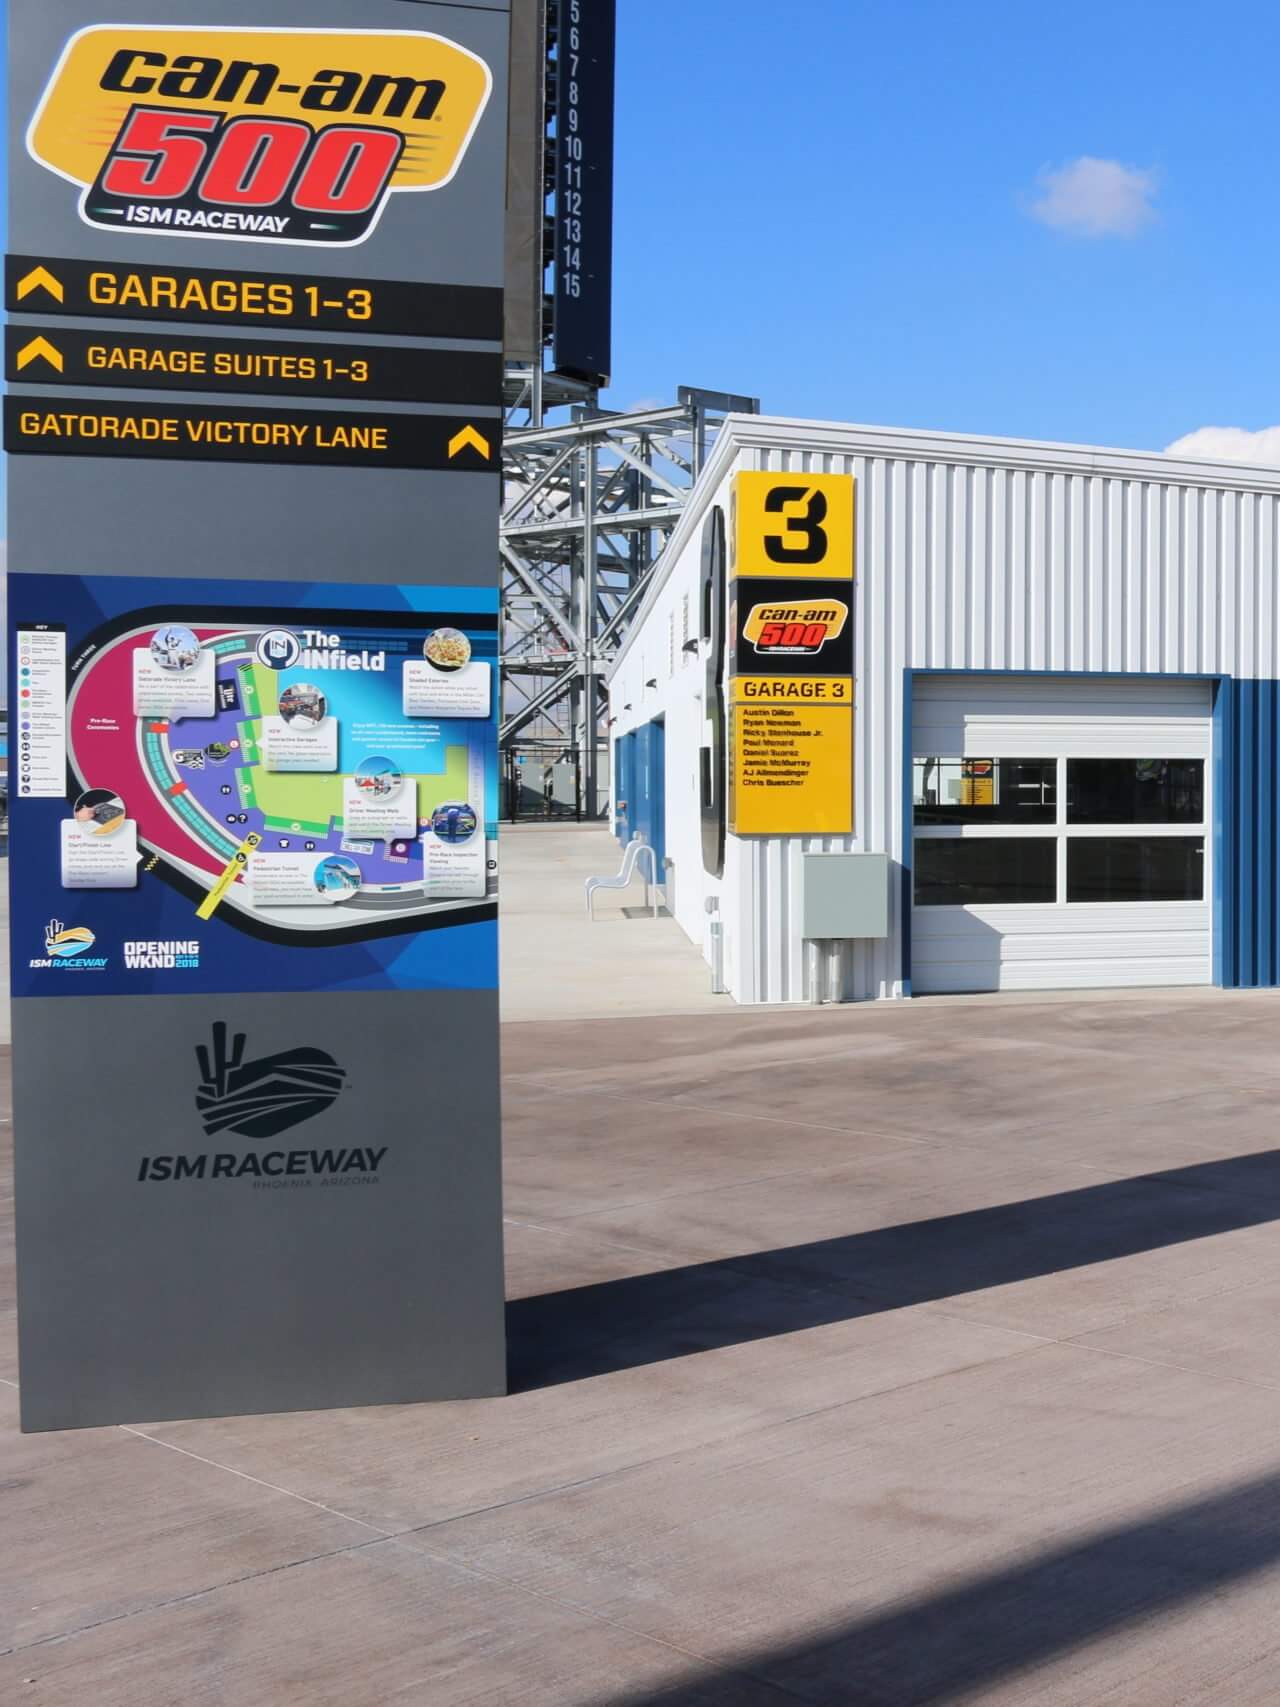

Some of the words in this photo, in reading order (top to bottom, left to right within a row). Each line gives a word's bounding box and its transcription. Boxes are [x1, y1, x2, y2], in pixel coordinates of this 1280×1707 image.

[568, 0, 579, 23] 5
[569, 27, 580, 50] 6
[569, 53, 579, 77] 7
[99, 48, 446, 120] can-am
[569, 81, 579, 105] 8
[568, 108, 578, 132] 9
[100, 106, 405, 214] 500
[565, 136, 582, 161] 10
[564, 163, 581, 189] 11
[564, 190, 581, 216] 12
[126, 204, 174, 224] ISM
[174, 207, 290, 234] RACEWAY
[563, 217, 581, 243] 13
[563, 245, 581, 271] 14
[88, 271, 293, 316] GARAGES
[563, 273, 580, 298] 15
[86, 346, 207, 374] GARAGE
[213, 352, 316, 379] SUITES
[19, 412, 179, 441] GATORADE
[185, 420, 309, 448] VICTORY
[314, 427, 388, 449] LANE
[764, 486, 828, 565] 3
[758, 609, 838, 621] can-am
[303, 630, 340, 647] The
[758, 622, 827, 647] 500
[303, 650, 386, 671] INfield
[744, 682, 826, 698] GARAGE
[832, 683, 844, 698] 3
[124, 941, 200, 955] OPENING
[29, 959, 52, 968] ISM
[52, 958, 109, 967] RACEWAY
[125, 955, 175, 968] WKND
[137, 1154, 208, 1182] ISM
[211, 1147, 388, 1179] RACEWAY
